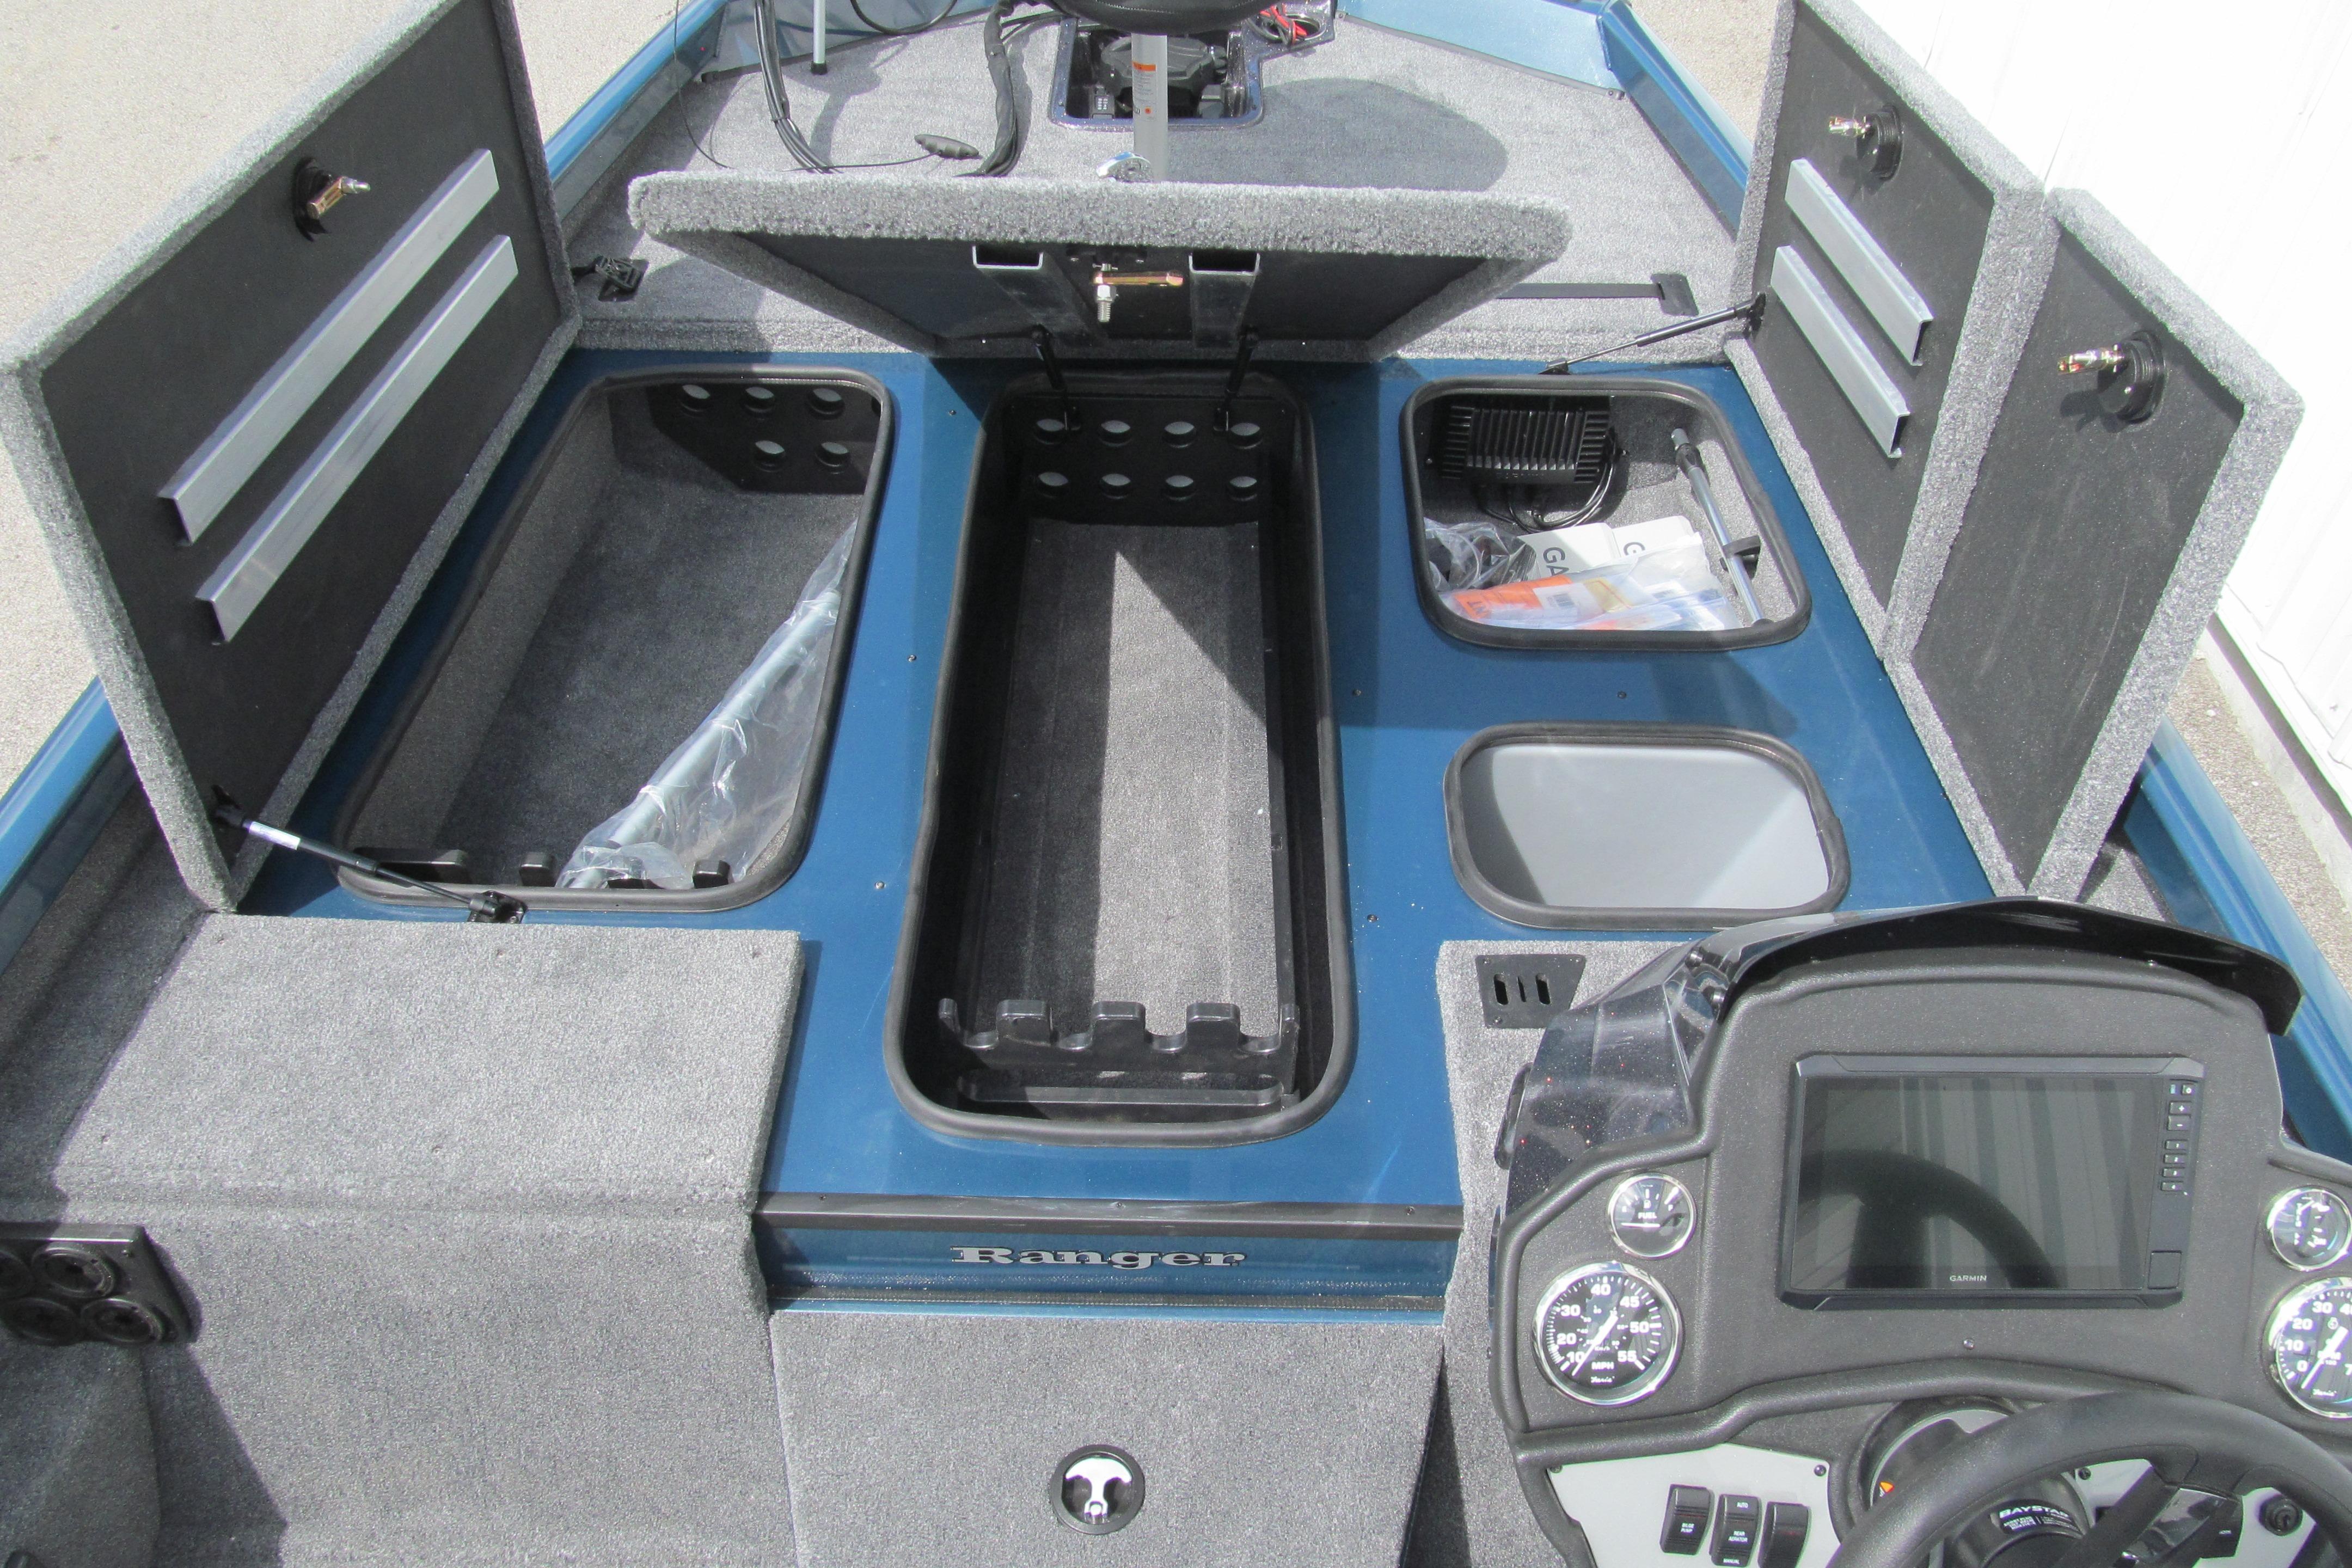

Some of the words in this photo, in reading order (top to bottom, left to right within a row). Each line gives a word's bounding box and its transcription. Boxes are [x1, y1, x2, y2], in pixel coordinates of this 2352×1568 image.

[950, 1245, 1247, 1270] Ranger
[1590, 1283, 1611, 1296] 40
[1619, 1296, 1640, 1308] 45
[2312, 1301, 2333, 1314] 30
[1560, 1304, 1581, 1316] 30
[1630, 1321, 1650, 1333] 50
[2292, 1318, 2313, 1330] 20
[1557, 1333, 1577, 1345] 20
[2285, 1339, 2304, 1352] 10
[1566, 1351, 1585, 1363] 10
[1618, 1350, 1637, 1363] 55
[1591, 1361, 1614, 1370] MPH
[2296, 1360, 2308, 1372] 0
[1999, 1505, 2069, 1518] BAYSTAR
